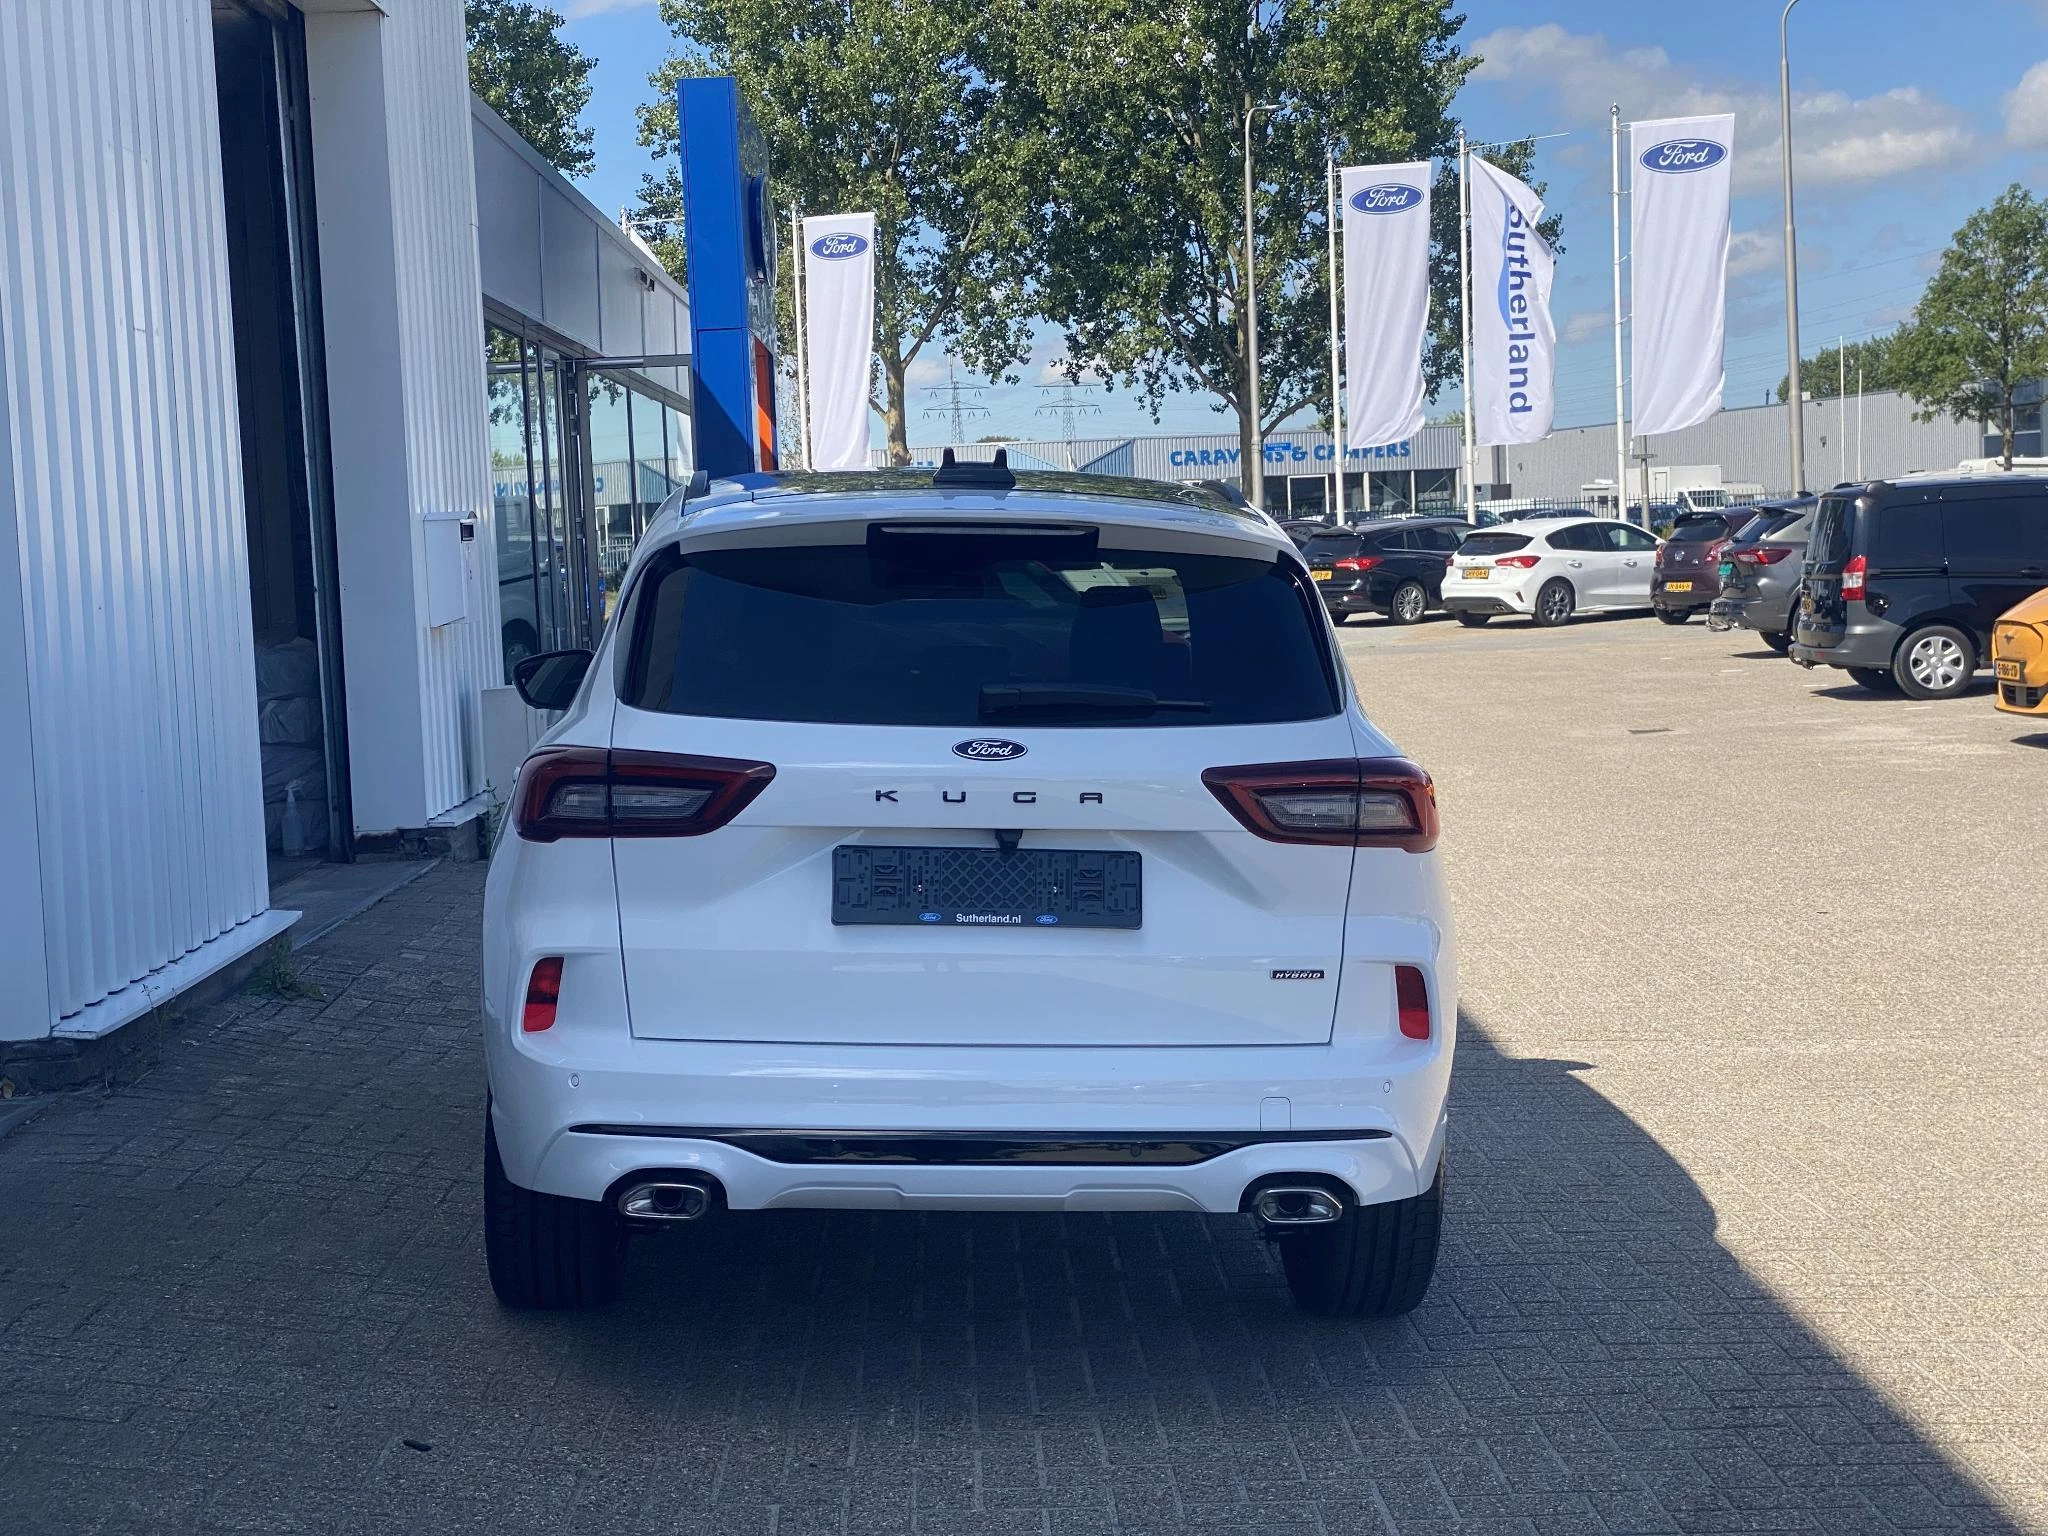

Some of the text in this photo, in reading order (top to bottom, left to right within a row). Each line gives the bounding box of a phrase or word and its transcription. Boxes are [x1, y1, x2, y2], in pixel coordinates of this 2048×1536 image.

[1658, 143, 1710, 166] Ford
[1365, 186, 1409, 208] Ford
[822, 235, 858, 255] Ford
[1291, 446, 1308, 462] &
[967, 740, 1013, 757] Ford
[875, 789, 1103, 805] KUGA
[955, 913, 1022, 924] Sutherland.nl
[1275, 971, 1322, 979] HYBRID
